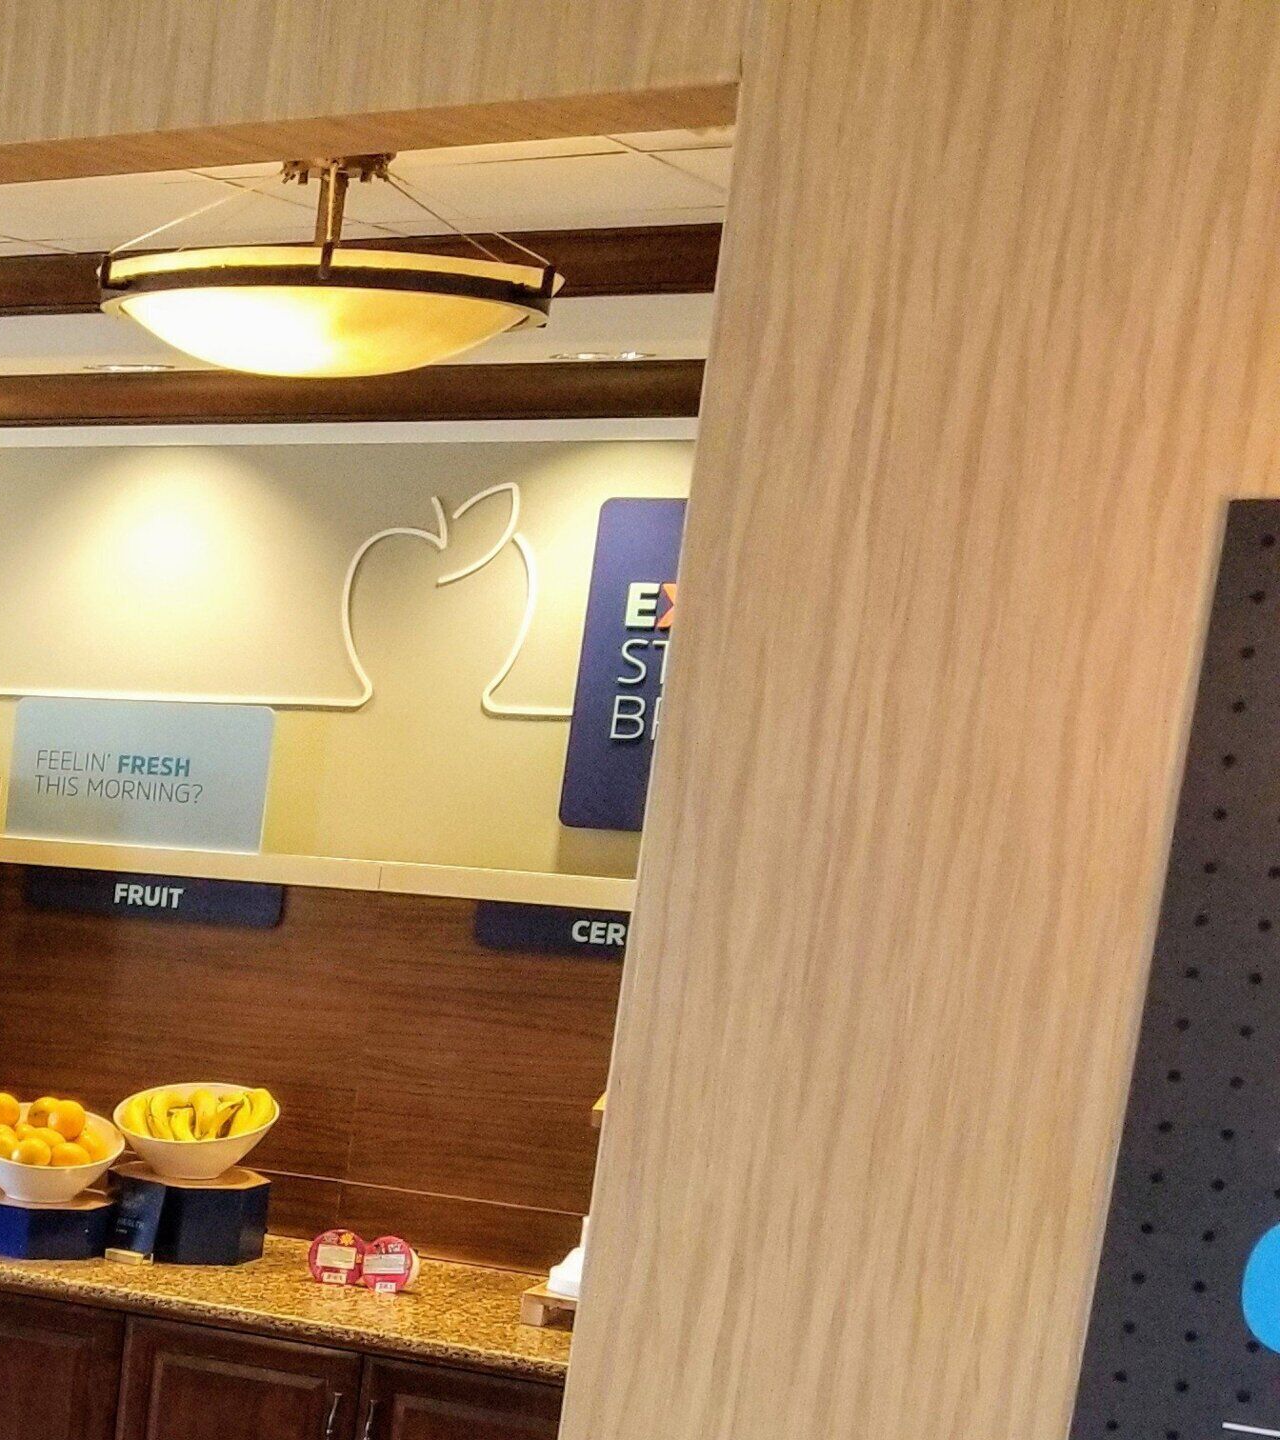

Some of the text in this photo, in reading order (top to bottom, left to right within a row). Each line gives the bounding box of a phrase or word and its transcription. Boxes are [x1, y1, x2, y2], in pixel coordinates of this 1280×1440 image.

[36, 749, 191, 778] FEELIN' FRESH
[35, 774, 204, 804] THIS MORNING?
[113, 882, 186, 909] FRUIT
[571, 920, 627, 946] CER
